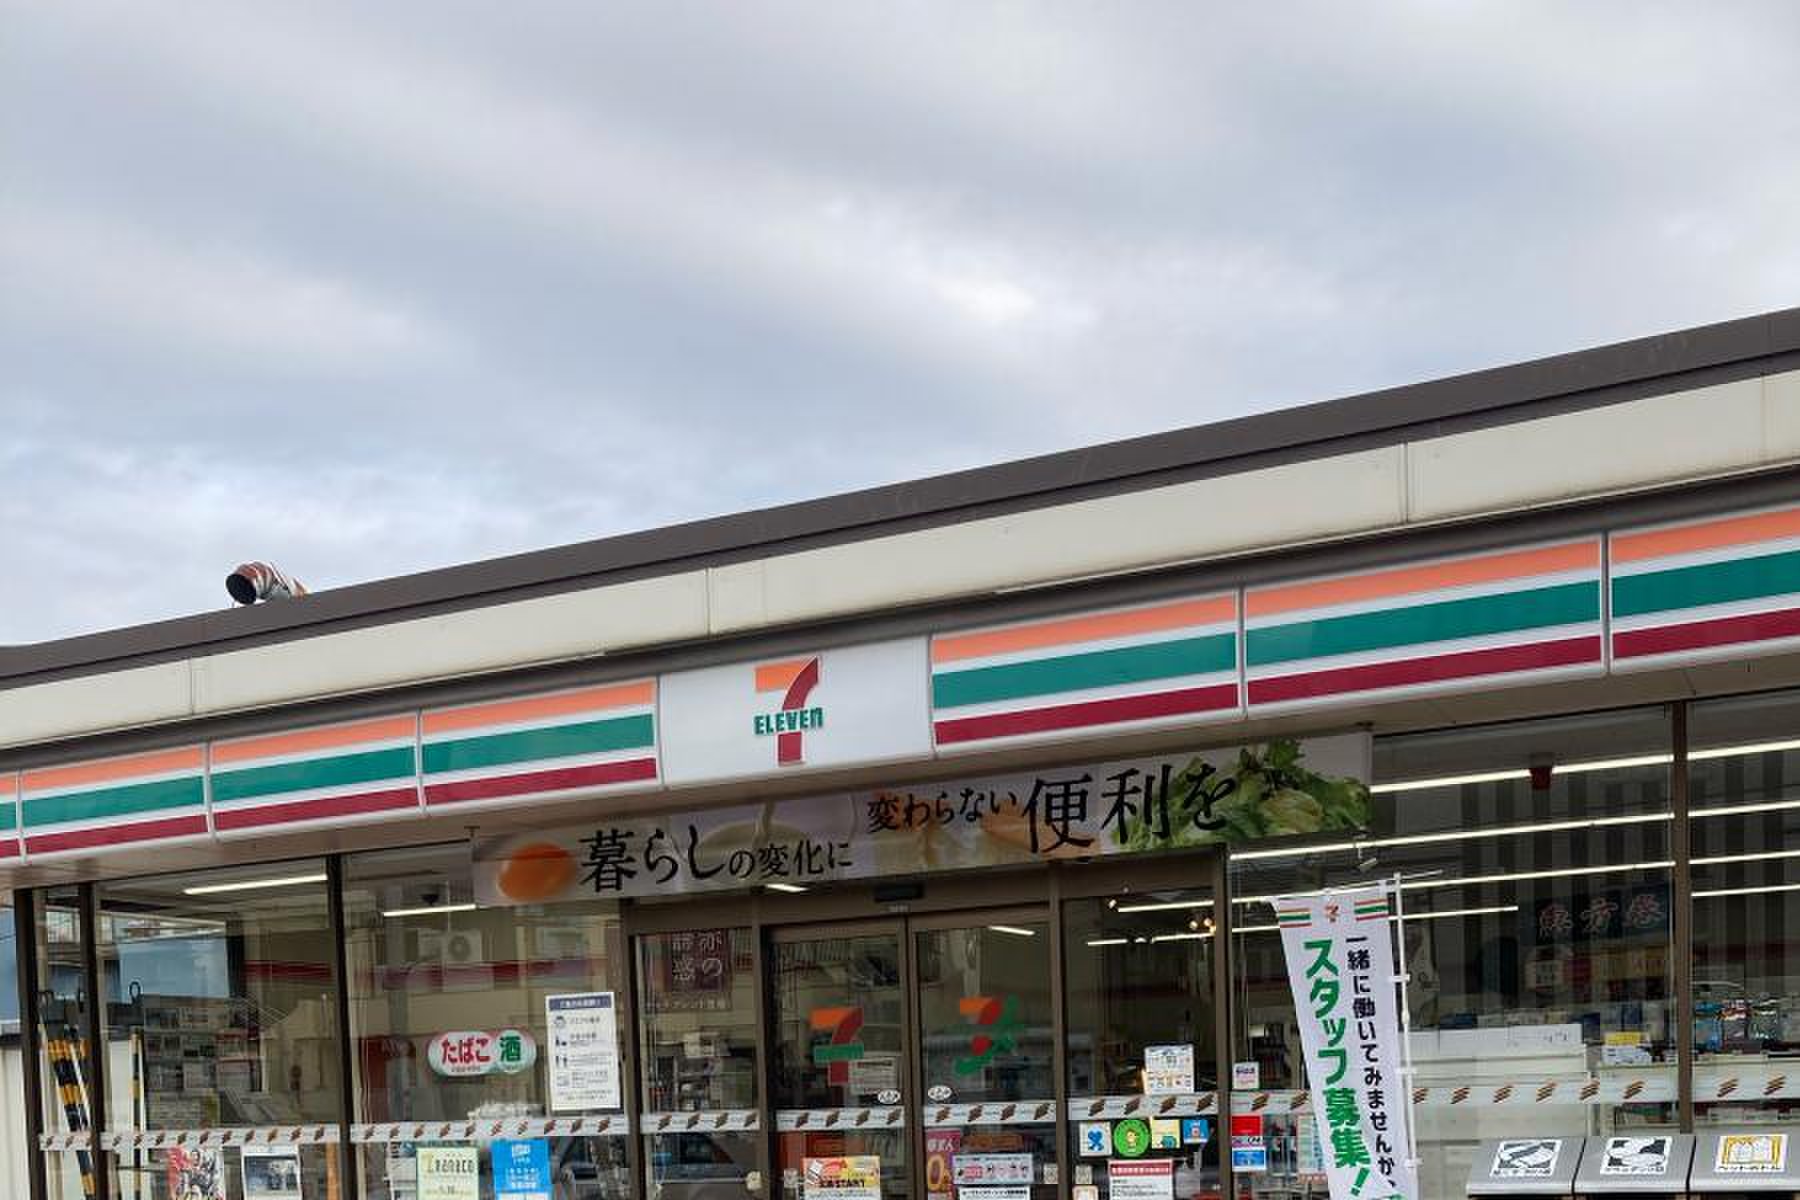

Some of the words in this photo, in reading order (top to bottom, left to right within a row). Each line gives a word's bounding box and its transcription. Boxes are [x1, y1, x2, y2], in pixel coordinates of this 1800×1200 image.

[755, 656, 819, 764] 7
[867, 762, 1237, 854] 変わらない便利を
[579, 823, 854, 893] 暮らしの変化に
[441, 1037, 490, 1064] たばこ
[500, 1036, 521, 1062] 酒
